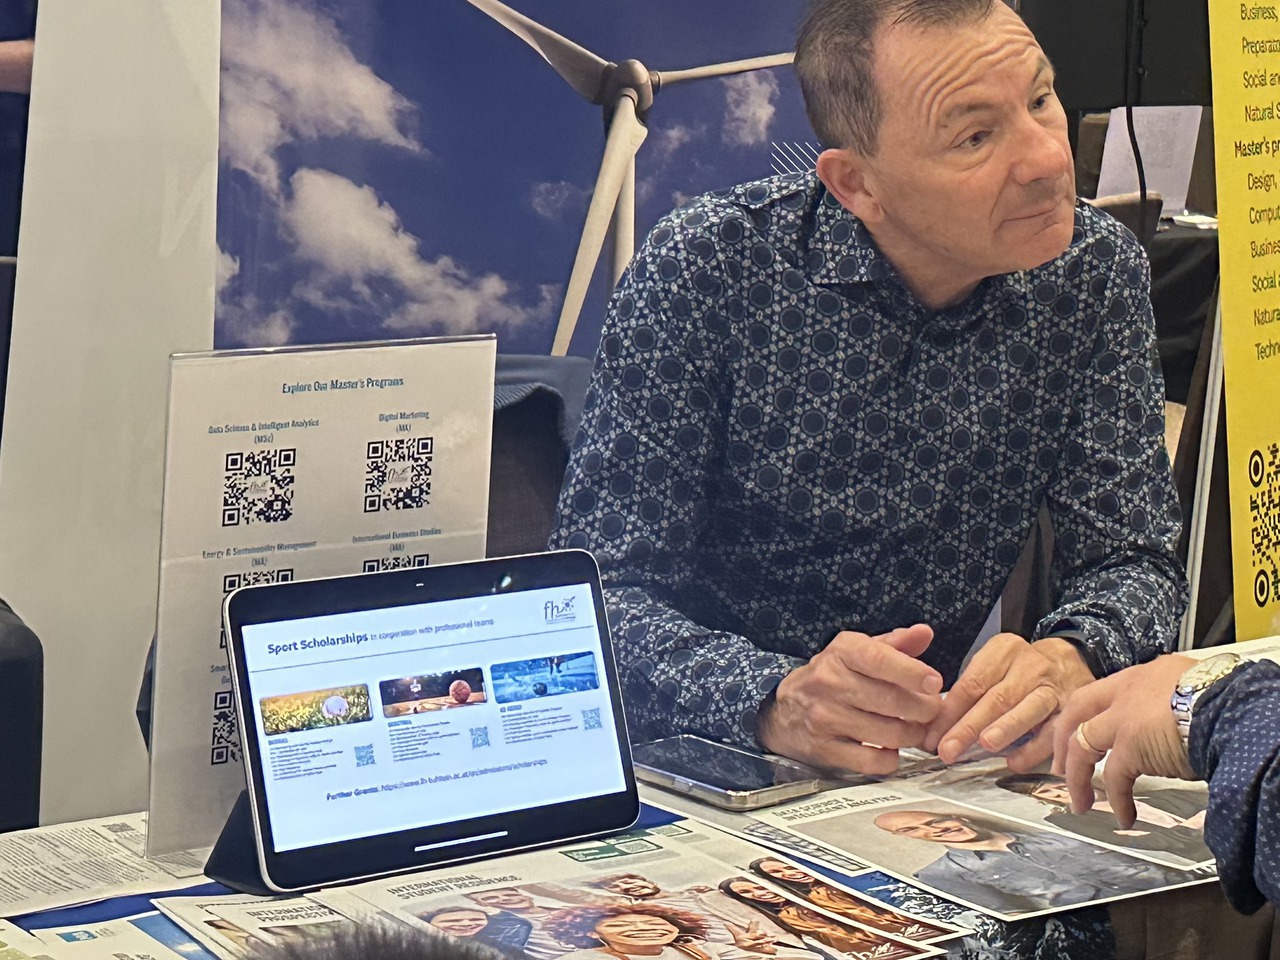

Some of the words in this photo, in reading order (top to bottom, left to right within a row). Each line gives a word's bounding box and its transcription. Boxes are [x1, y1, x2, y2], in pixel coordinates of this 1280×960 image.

[1240, 1, 1278, 22] Business,
[1243, 68, 1268, 89] Social
[1244, 102, 1274, 123] Natural
[1234, 136, 1270, 158] Master's
[1247, 169, 1277, 193] Design,
[1252, 272, 1277, 293] Social
[282, 381, 312, 394] Explore
[313, 381, 327, 391] Our
[330, 379, 365, 390] Master's
[366, 378, 404, 389] Programs
[291, 419, 319, 428] Analytics
[254, 433, 274, 444] (MSc)
[267, 642, 298, 656] Sport
[300, 632, 369, 650] Scholarships
